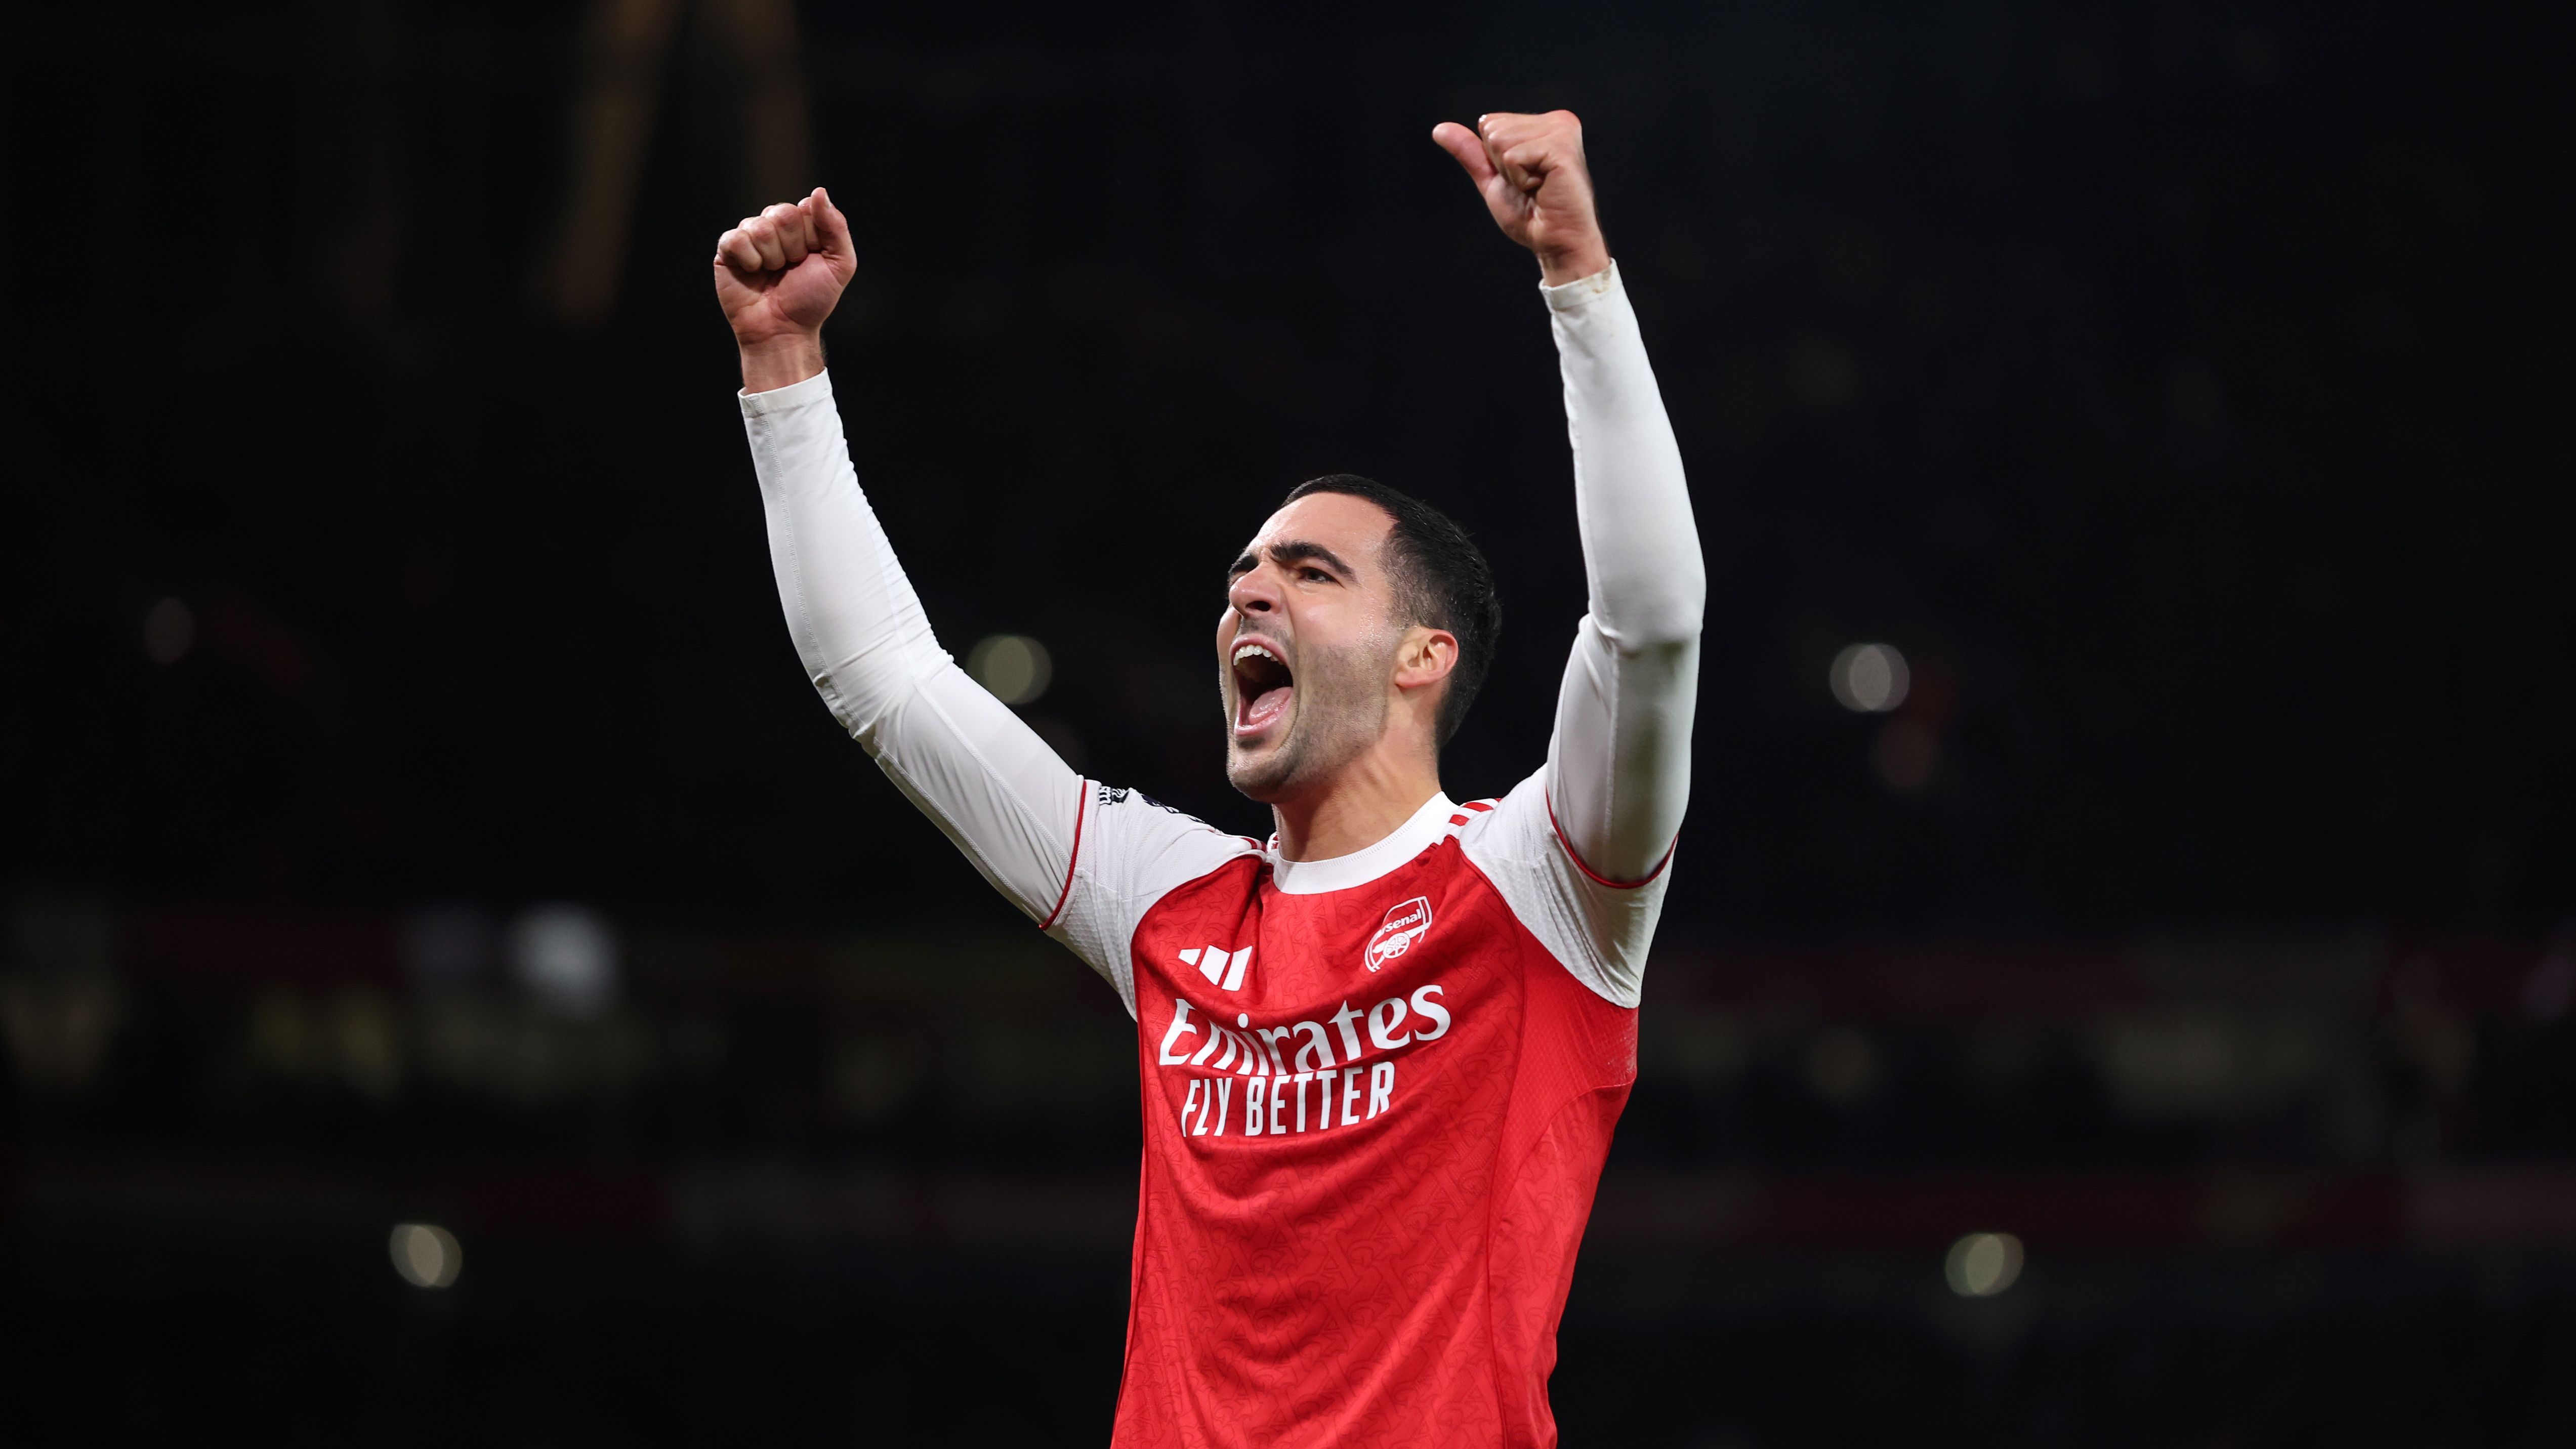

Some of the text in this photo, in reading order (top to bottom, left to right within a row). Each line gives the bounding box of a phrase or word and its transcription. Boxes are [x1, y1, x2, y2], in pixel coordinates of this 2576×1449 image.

[1158, 984, 1451, 1076] Emirates
[1181, 1061, 1395, 1137] FLY BETTER
